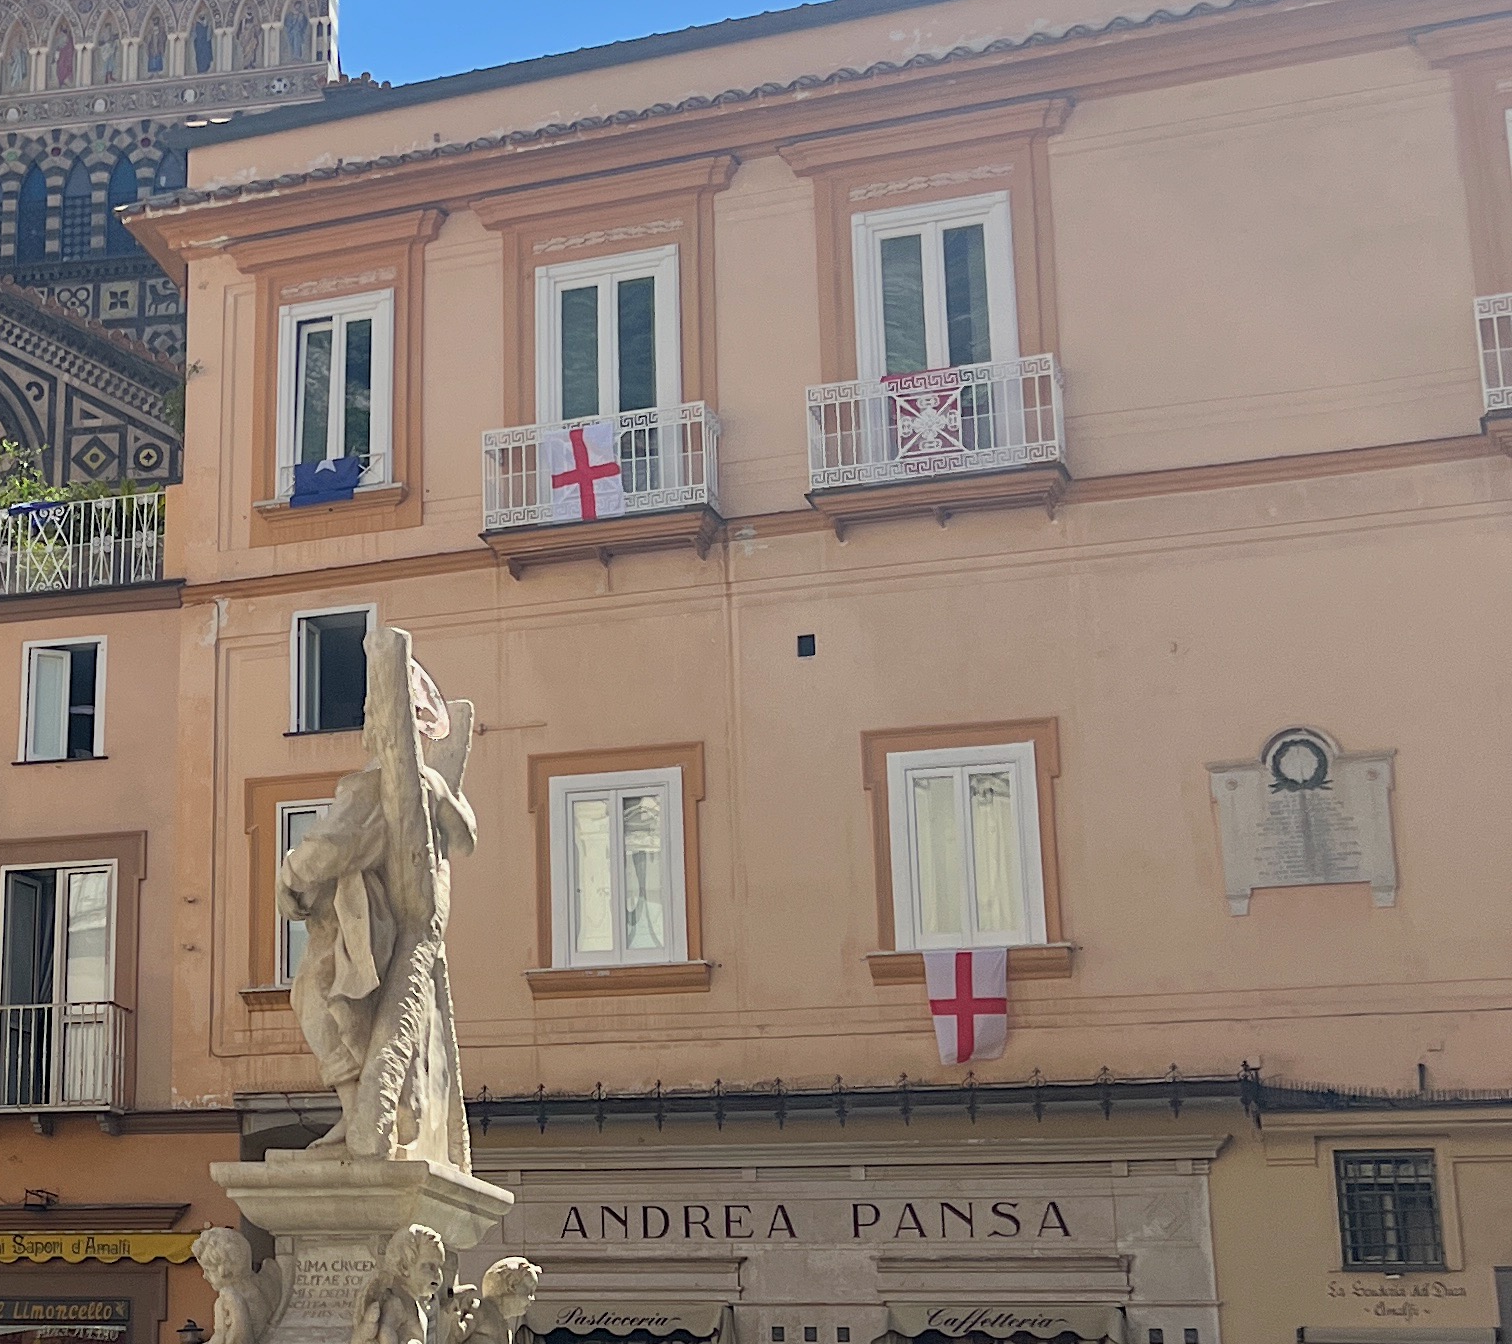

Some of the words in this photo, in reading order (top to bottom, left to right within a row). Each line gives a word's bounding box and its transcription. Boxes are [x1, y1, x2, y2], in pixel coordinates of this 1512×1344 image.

[560, 1205, 798, 1239] ANDREA
[851, 1201, 1072, 1238] PANSA
[12, 1235, 63, 1256] Sapori
[556, 1306, 672, 1326] Pasticceria
[926, 1307, 1058, 1333] Caffetteria
